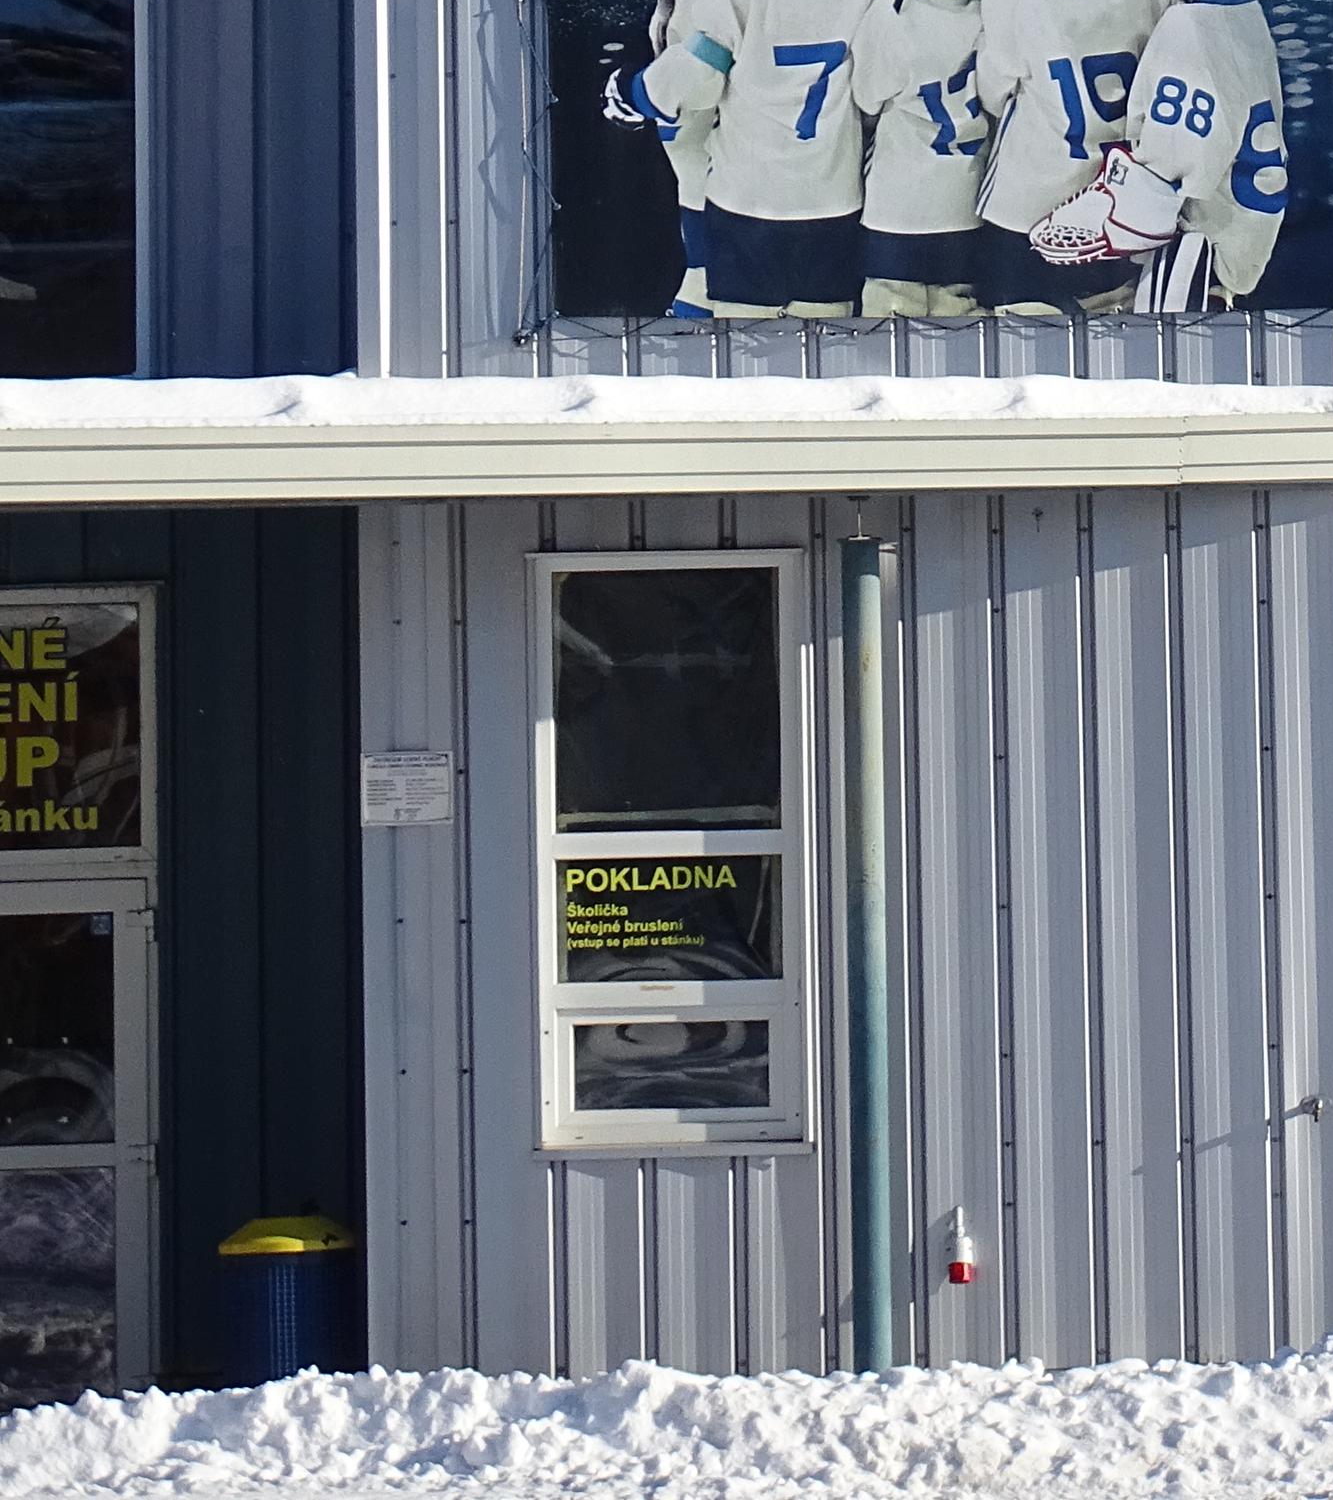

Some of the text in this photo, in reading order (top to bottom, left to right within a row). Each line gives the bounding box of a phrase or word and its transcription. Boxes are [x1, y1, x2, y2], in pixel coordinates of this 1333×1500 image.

[772, 40, 848, 142] 7
[1150, 76, 1216, 138] 88
[565, 865, 737, 894] POKLADNA
[566, 901, 629, 918] Školička
[566, 920, 684, 936] Veřejné bruslení
